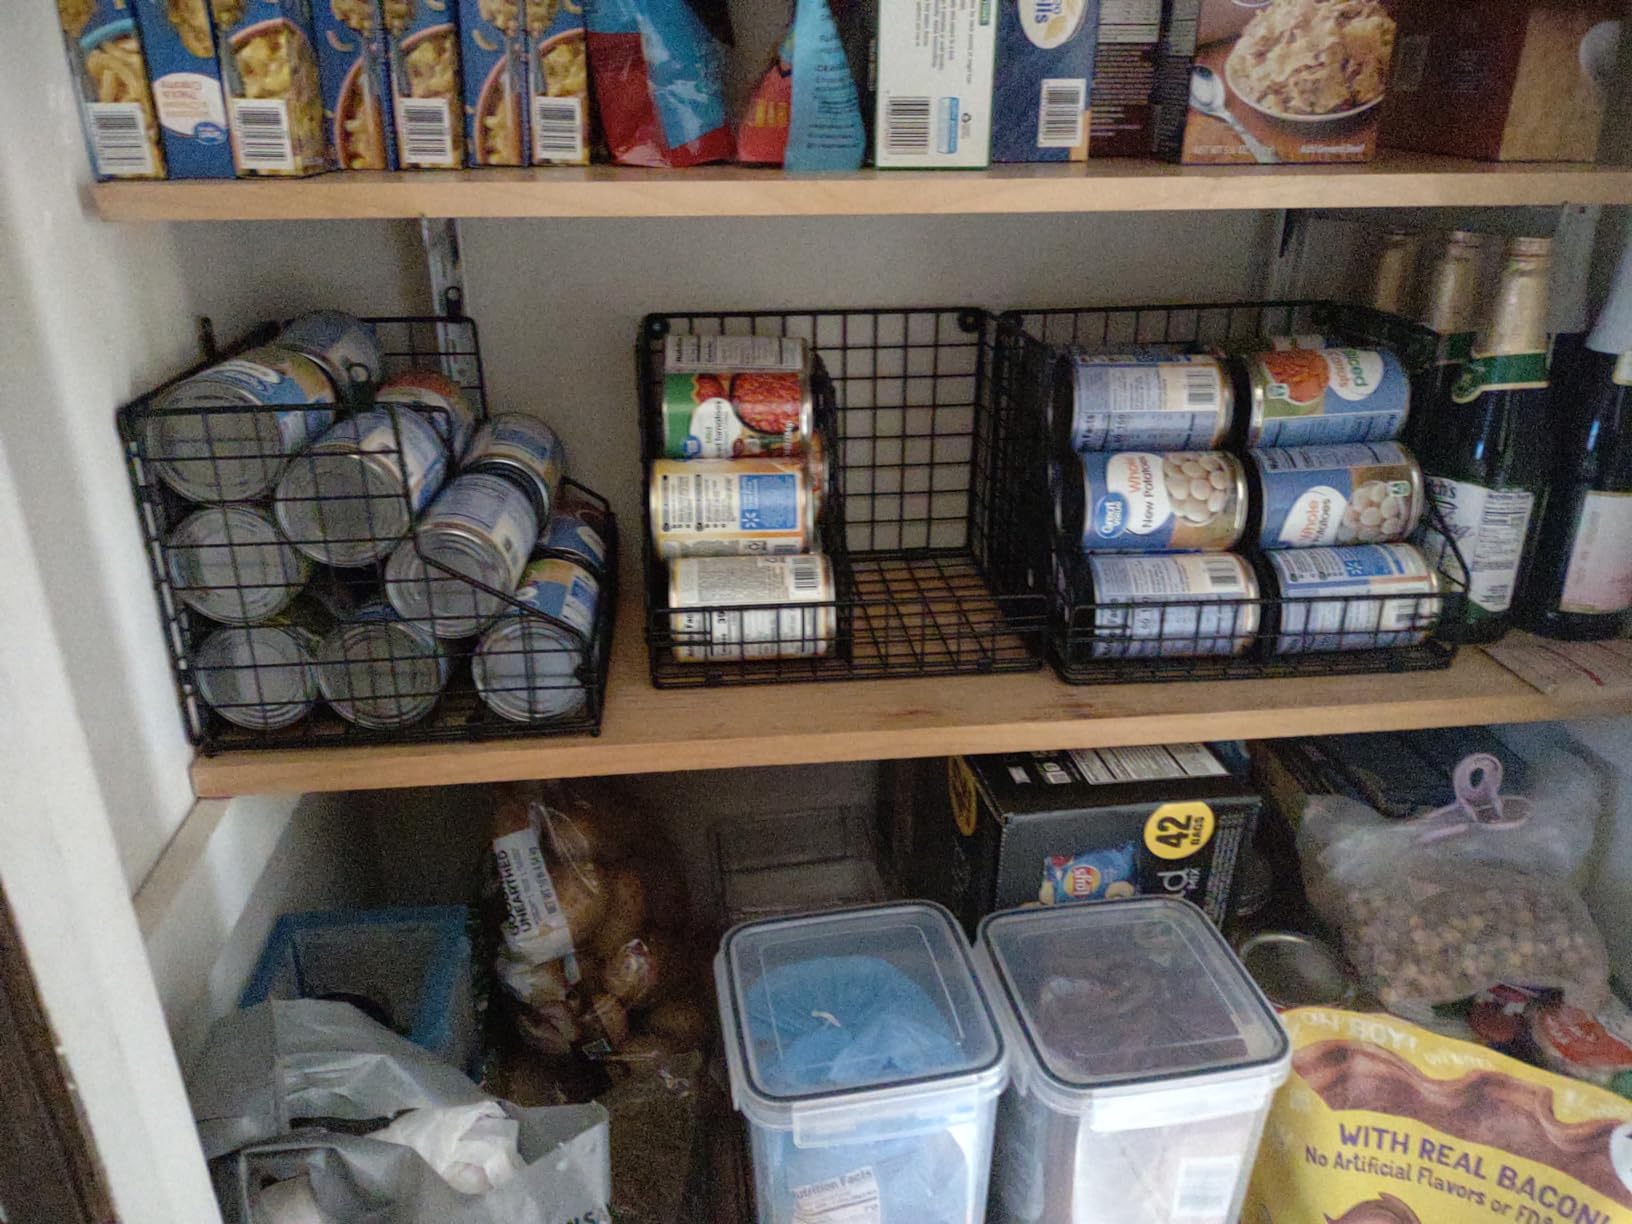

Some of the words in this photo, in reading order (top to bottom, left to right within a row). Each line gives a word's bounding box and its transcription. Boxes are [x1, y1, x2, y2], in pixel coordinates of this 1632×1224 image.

[1142, 501, 1154, 528] New
[1155, 814, 1194, 849] 42
[1190, 816, 1205, 847] BAGS
[497, 850, 531, 933] UNEARTHED
[1186, 868, 1201, 890] MIX
[1339, 1122, 1410, 1155] WITH
[1418, 1137, 1488, 1181] REAL
[1304, 1144, 1329, 1169] No
[1333, 1150, 1413, 1183] Artificial
[1416, 1166, 1487, 1207] Flavors
[1490, 1196, 1512, 1217] or
